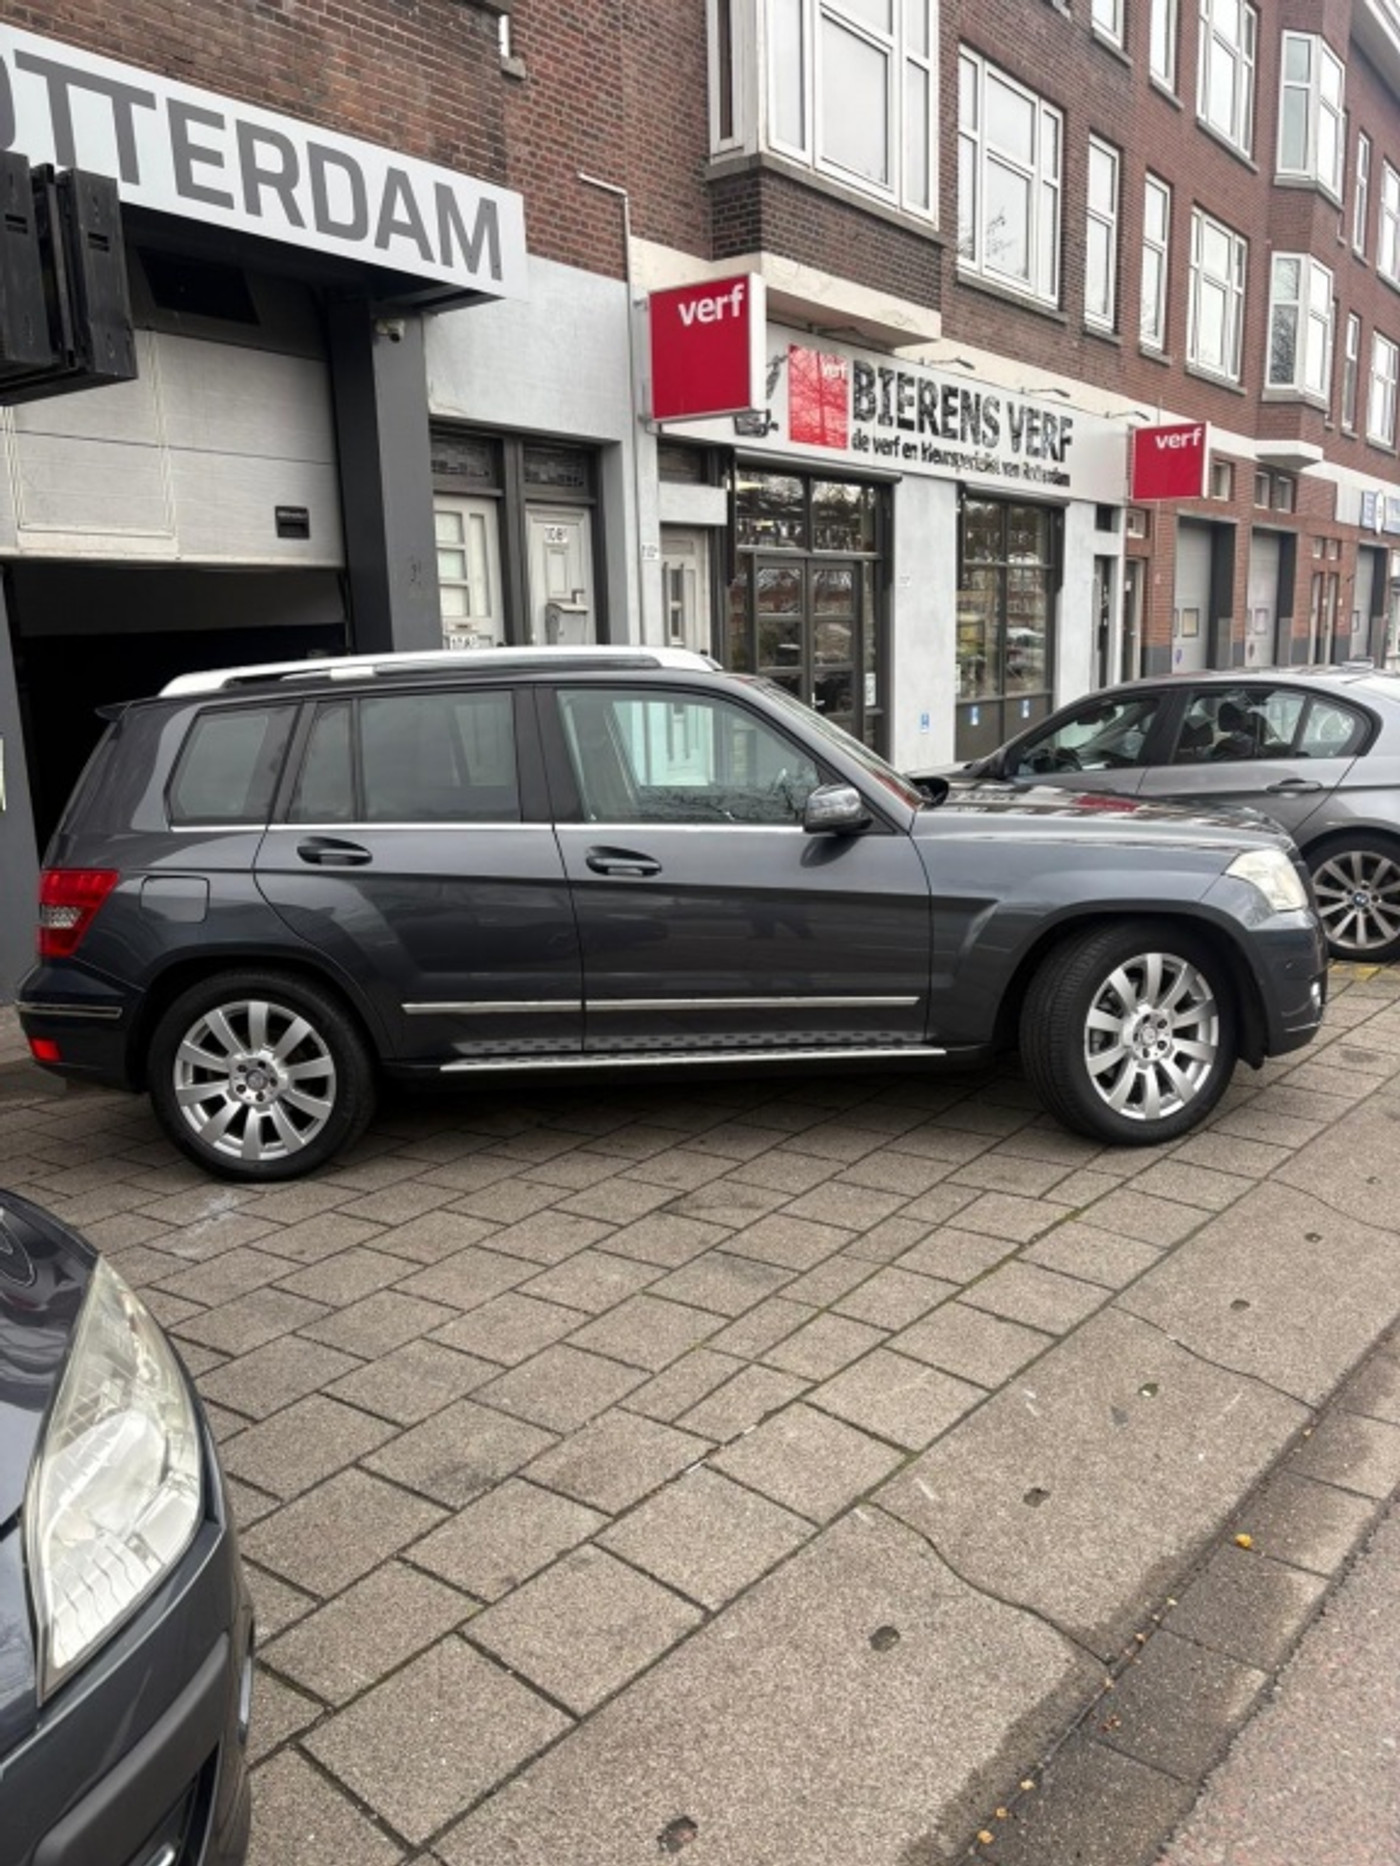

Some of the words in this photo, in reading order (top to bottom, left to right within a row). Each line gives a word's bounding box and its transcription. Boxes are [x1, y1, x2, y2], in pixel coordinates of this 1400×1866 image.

[0, 49, 503, 281] TTERDAM
[678, 283, 745, 327] verf
[822, 362, 847, 379] verf
[852, 361, 1000, 449] BIERENS
[1007, 401, 1074, 463] VERF
[851, 428, 869, 453] de
[873, 435, 900, 458] verf
[902, 442, 918, 461] en
[1154, 426, 1203, 450] verf
